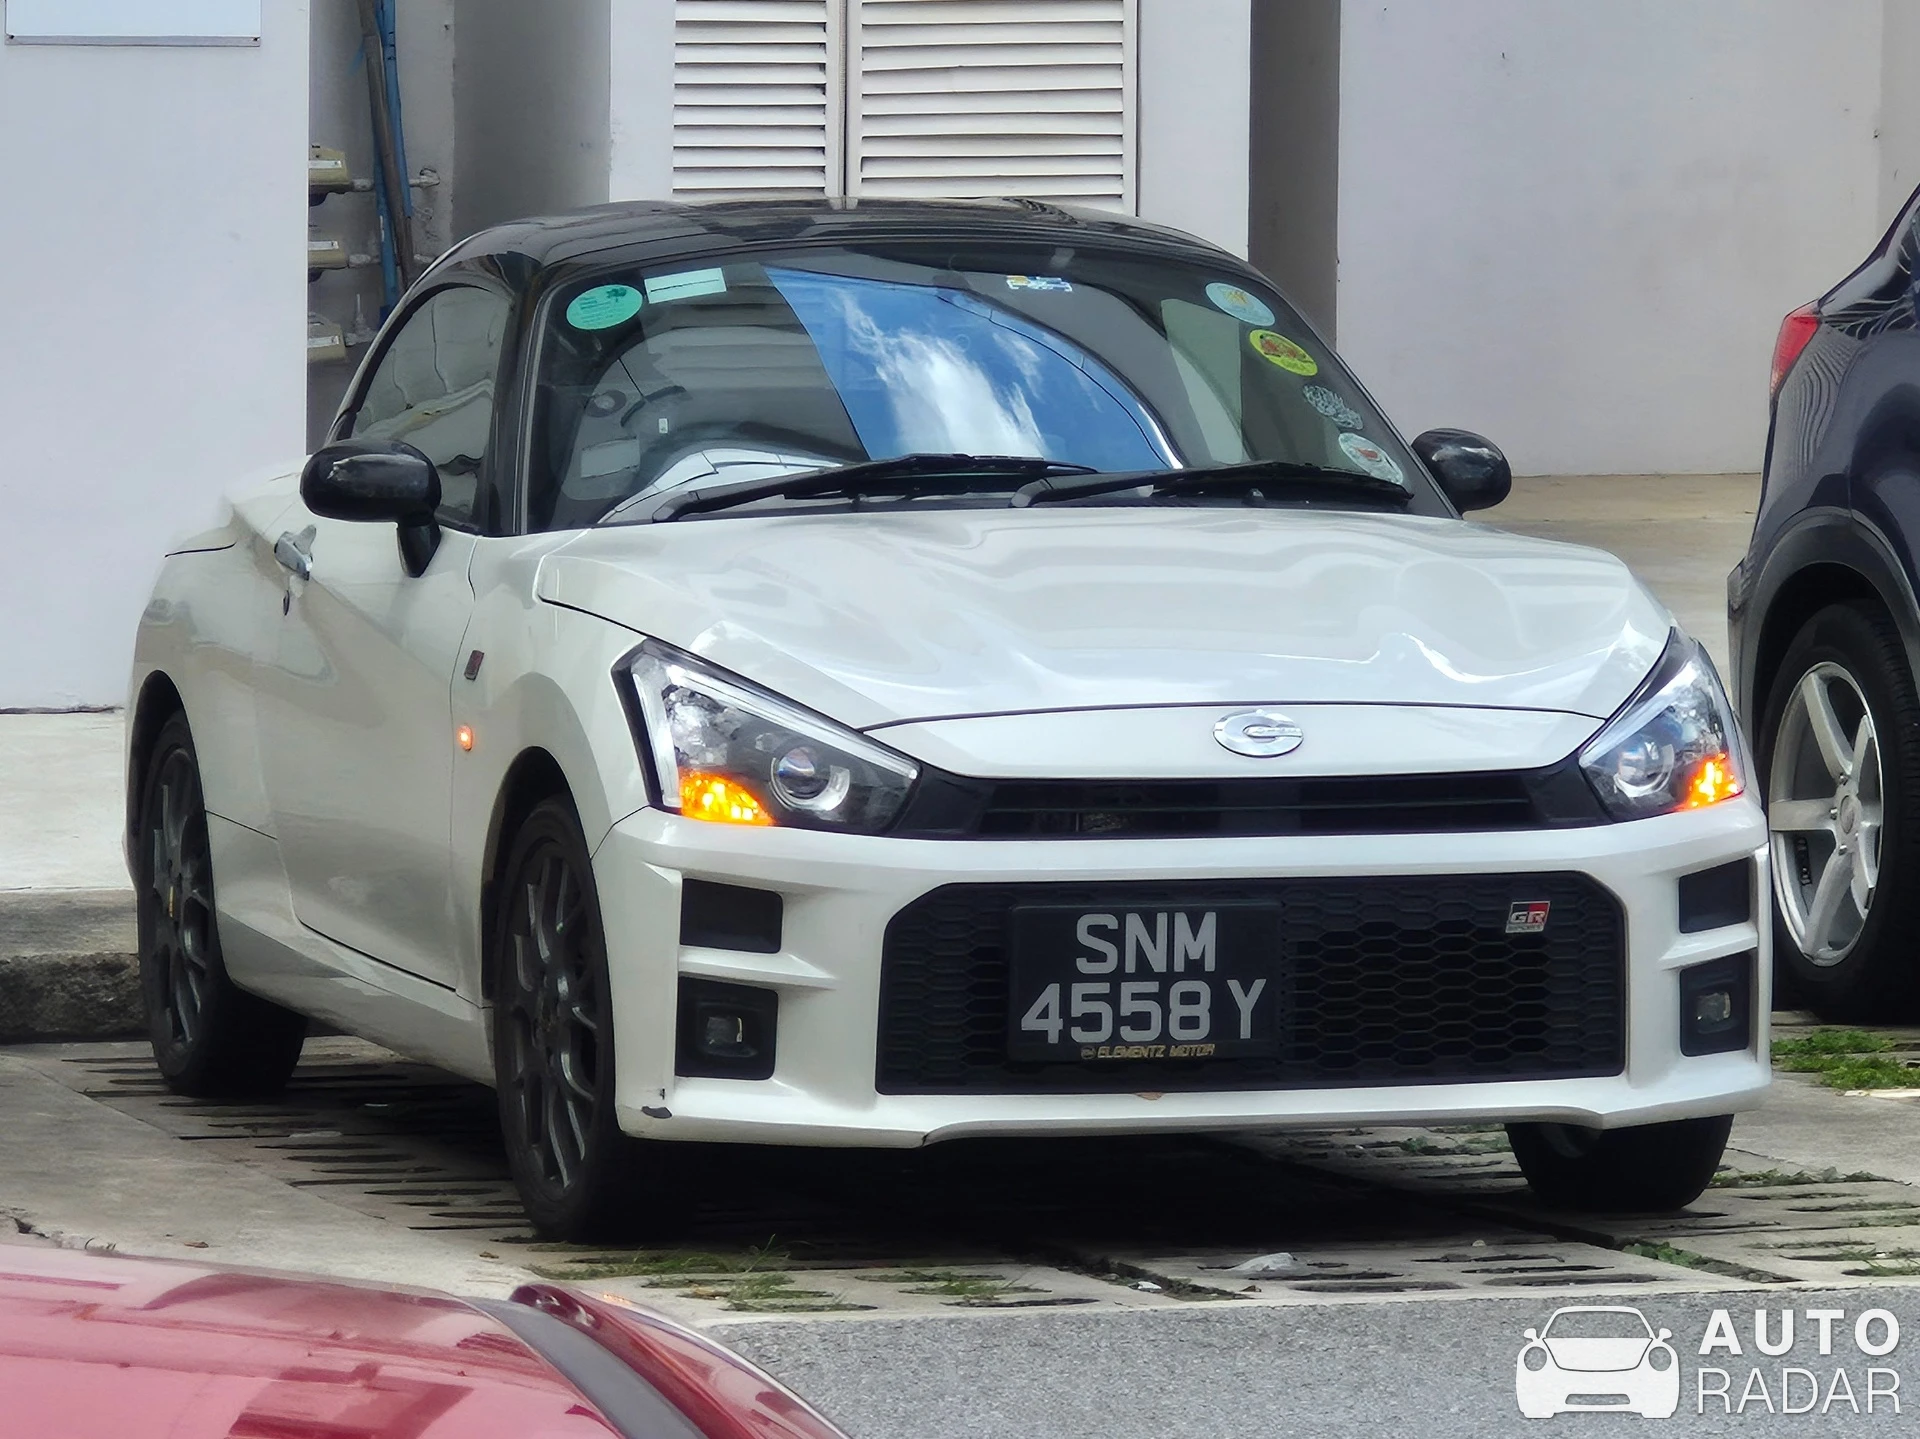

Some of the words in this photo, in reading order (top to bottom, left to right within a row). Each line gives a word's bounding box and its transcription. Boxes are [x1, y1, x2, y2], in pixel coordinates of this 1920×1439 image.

[1510, 911, 1545, 923] GR
[1076, 911, 1217, 974] SNM
[1021, 979, 1211, 1043] 4558
[1226, 978, 1267, 1039] Y
[1169, 1043, 1215, 1057] MOTOR
